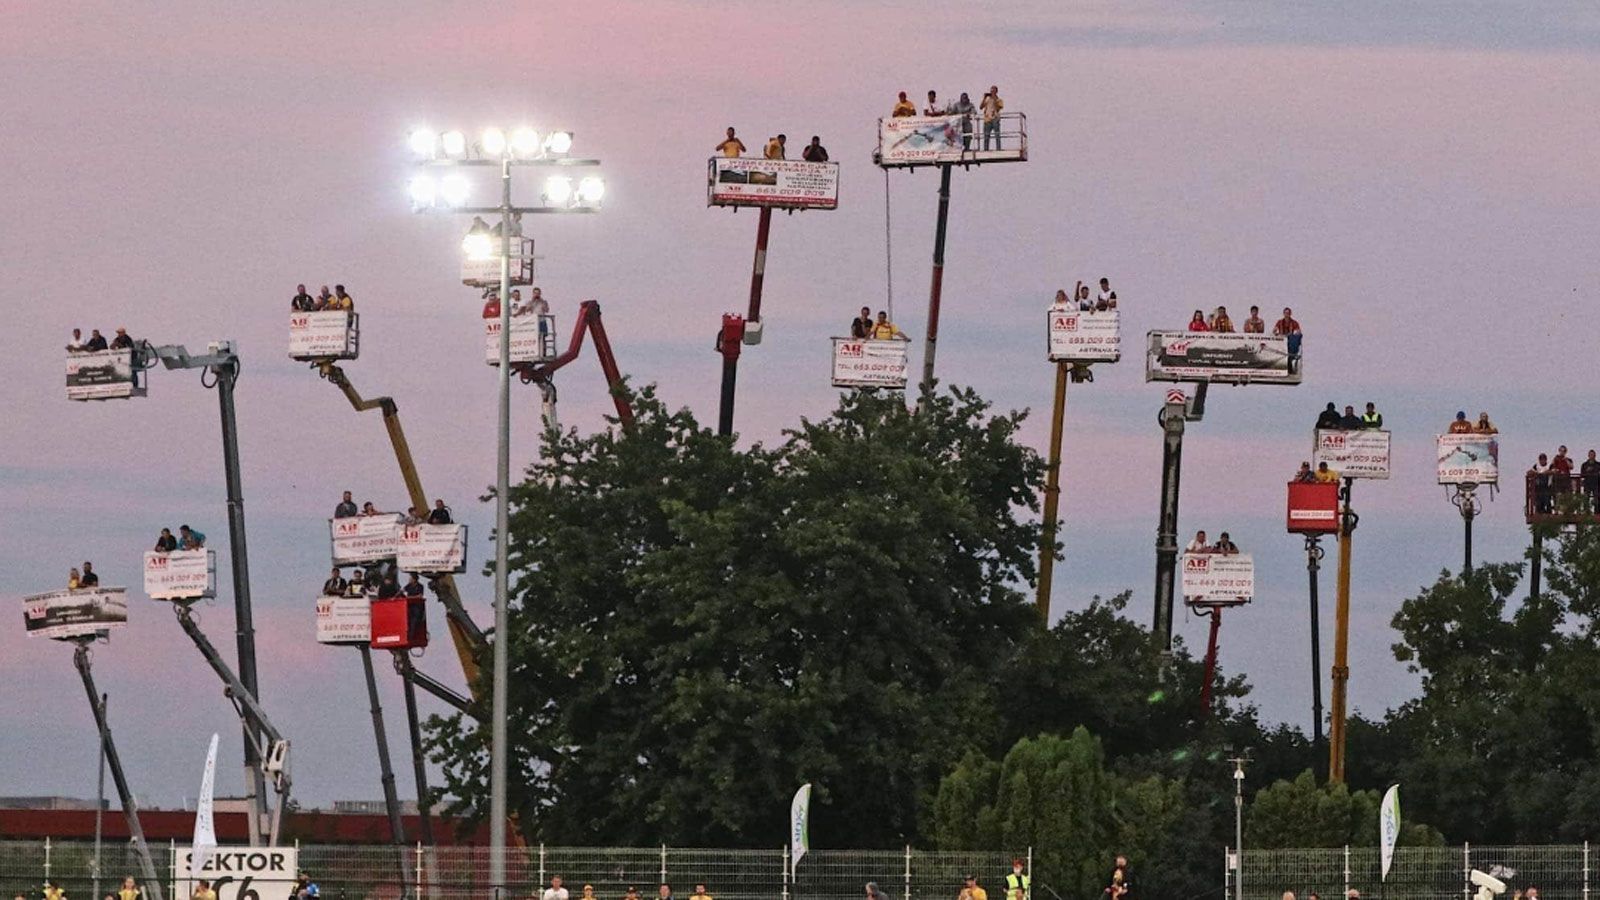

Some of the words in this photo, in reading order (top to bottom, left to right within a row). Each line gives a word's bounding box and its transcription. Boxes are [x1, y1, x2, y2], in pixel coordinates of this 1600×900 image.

[756, 187, 775, 195] 665
[1055, 317, 1076, 326] AB
[841, 343, 862, 352] AB
[1322, 435, 1344, 444] AB
[1186, 559, 1207, 568] AB
